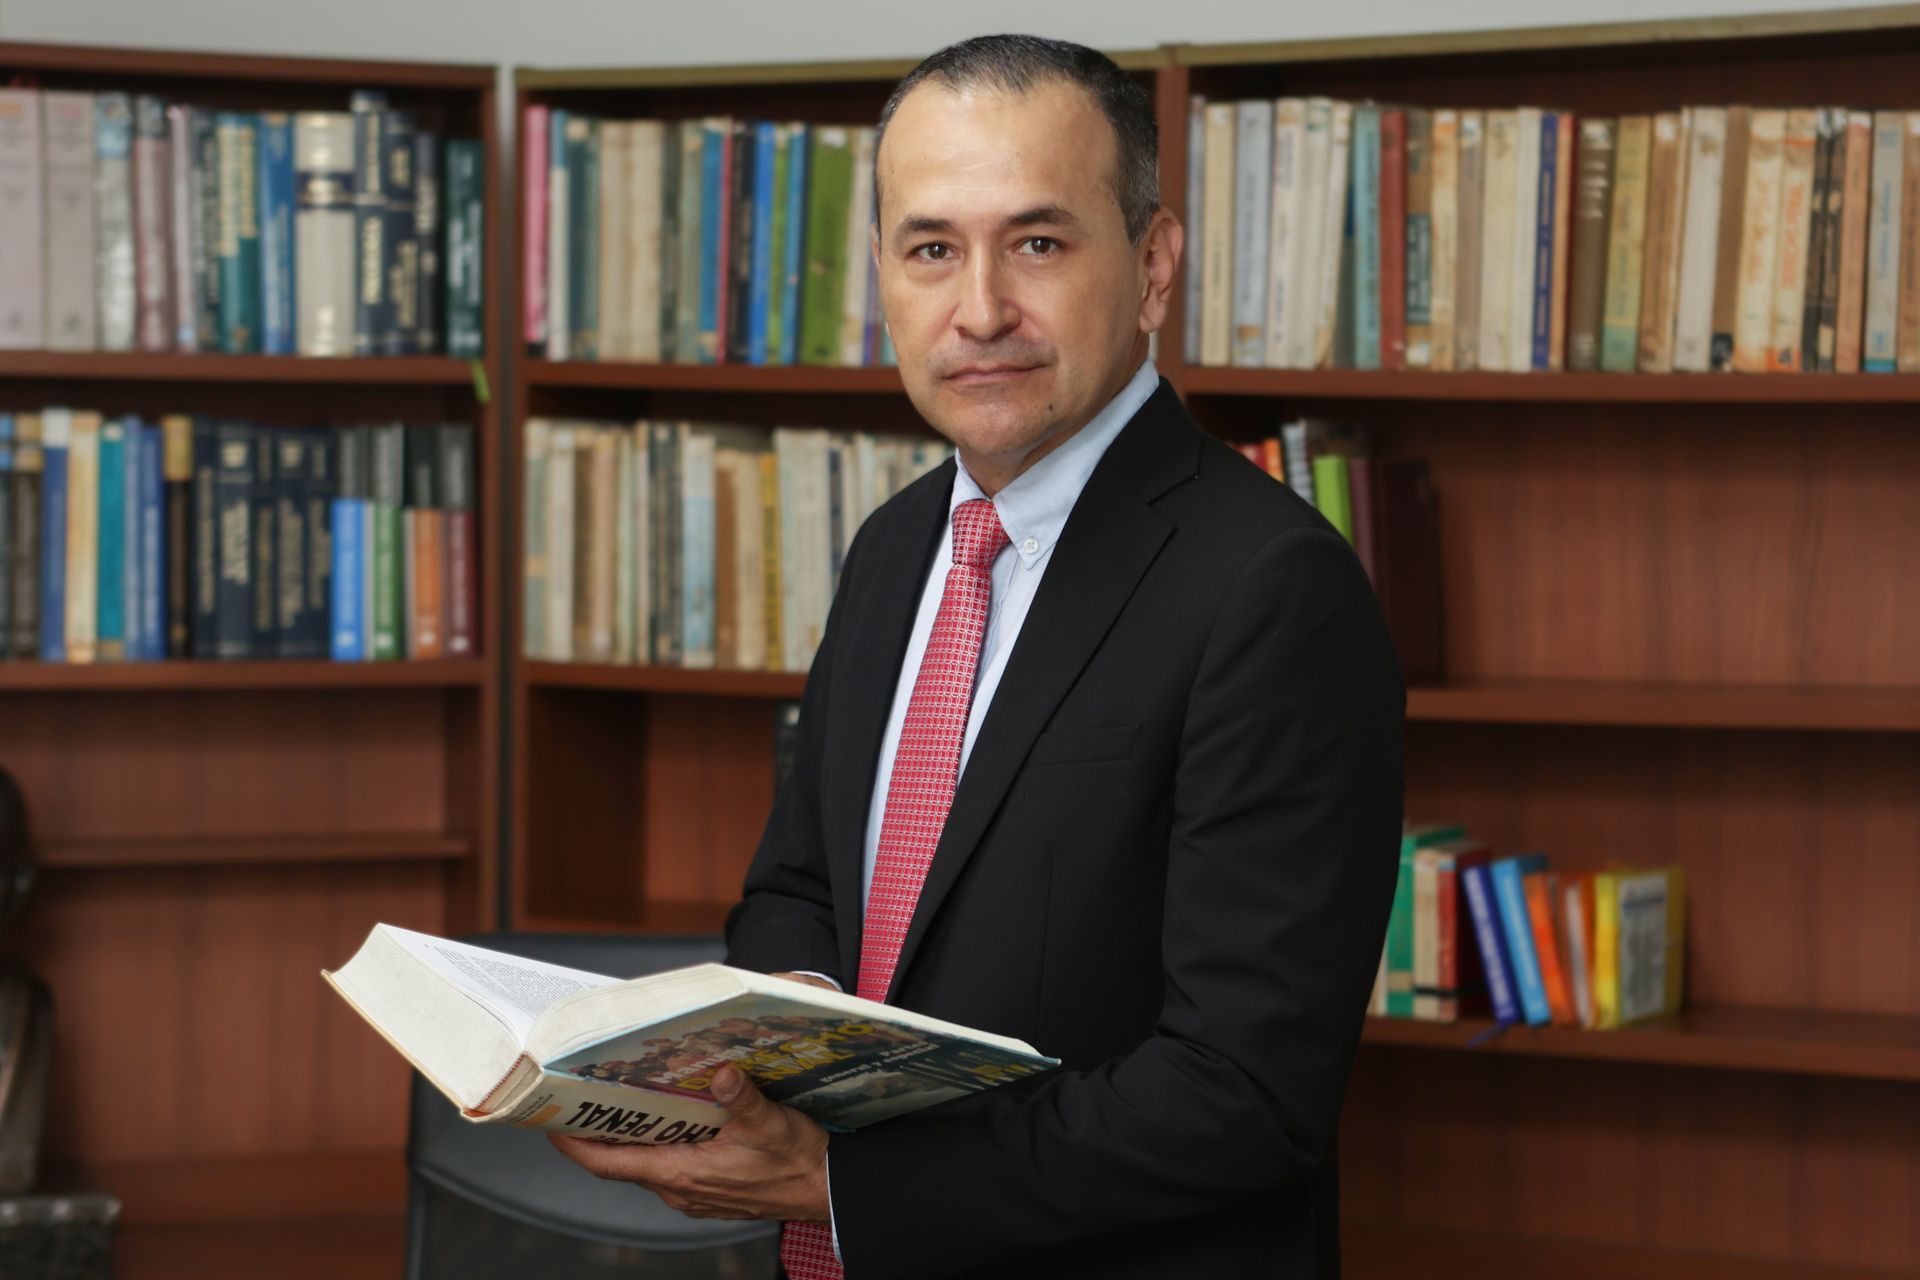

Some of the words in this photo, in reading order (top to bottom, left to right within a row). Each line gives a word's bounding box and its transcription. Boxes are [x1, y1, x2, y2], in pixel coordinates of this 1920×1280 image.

[650, 1044, 752, 1084] Manual
[753, 1033, 794, 1047] de
[565, 1101, 666, 1138] PENAL
